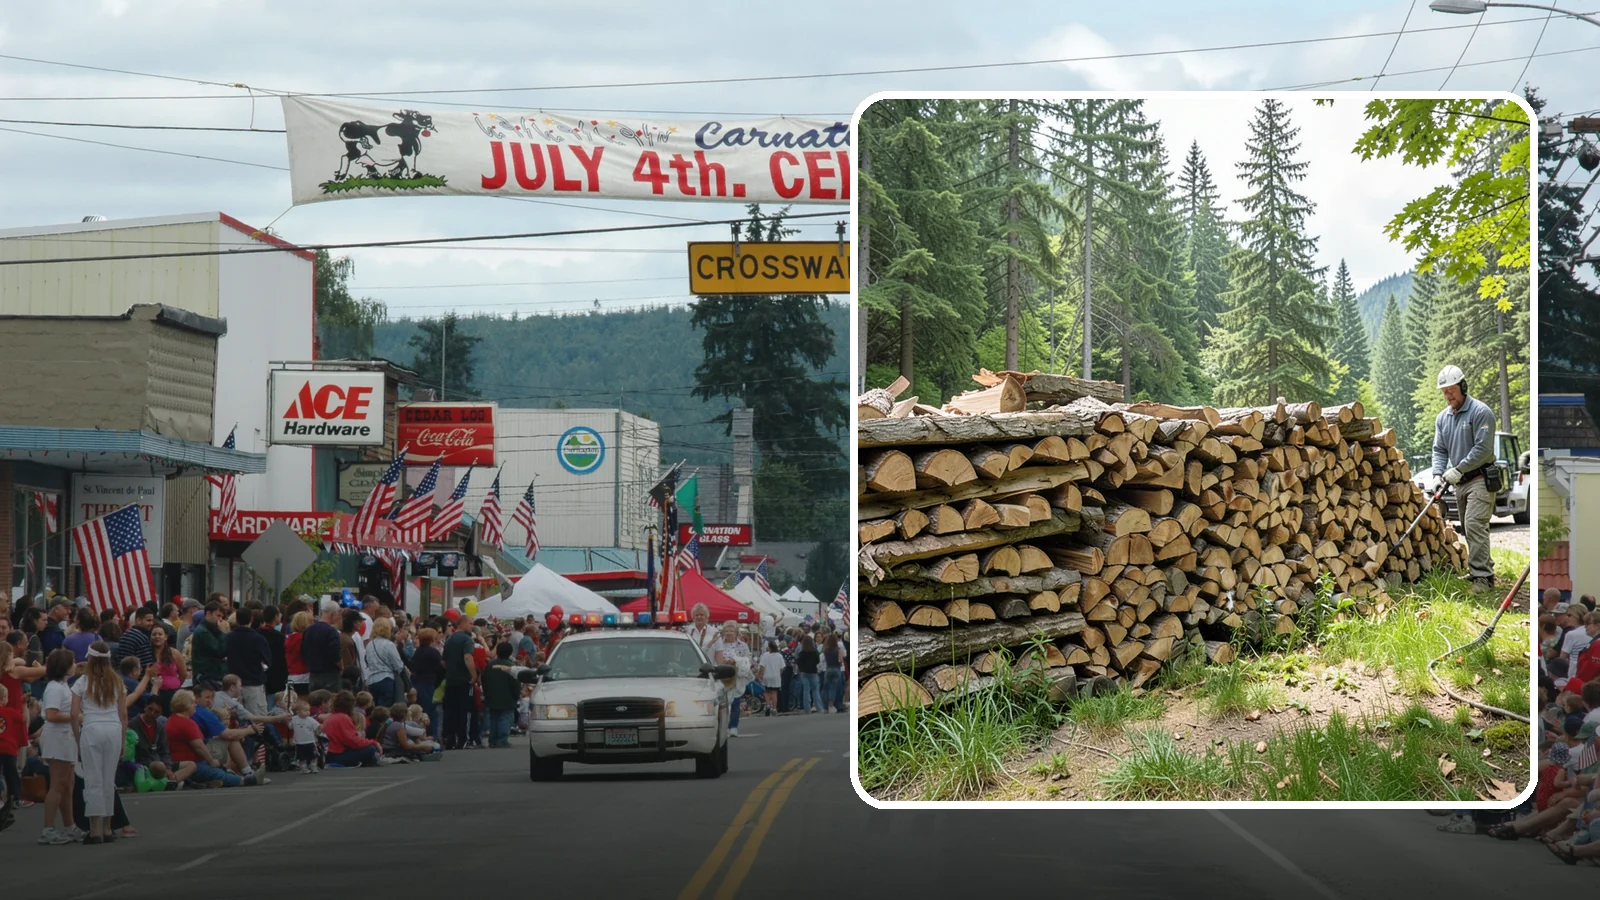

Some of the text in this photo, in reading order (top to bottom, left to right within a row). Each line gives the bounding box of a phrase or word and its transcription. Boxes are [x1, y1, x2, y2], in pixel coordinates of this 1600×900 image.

[695, 121, 850, 150] Carnat
[481, 141, 605, 193] JULY
[632, 150, 746, 198] 4th.
[697, 254, 850, 280] CROSSWA
[283, 380, 373, 419] ACE
[406, 410, 452, 421] CEDAR
[284, 421, 370, 436] Hardware
[416, 428, 476, 446] Coca-Cola
[353, 467, 384, 480] Simpl
[96, 485, 124, 495] Vincent
[126, 486, 135, 495] de
[138, 486, 155, 495] Paul
[213, 516, 331, 535] HARDARE
[688, 526, 741, 535] CRNATION
[699, 535, 730, 543] GLASS
